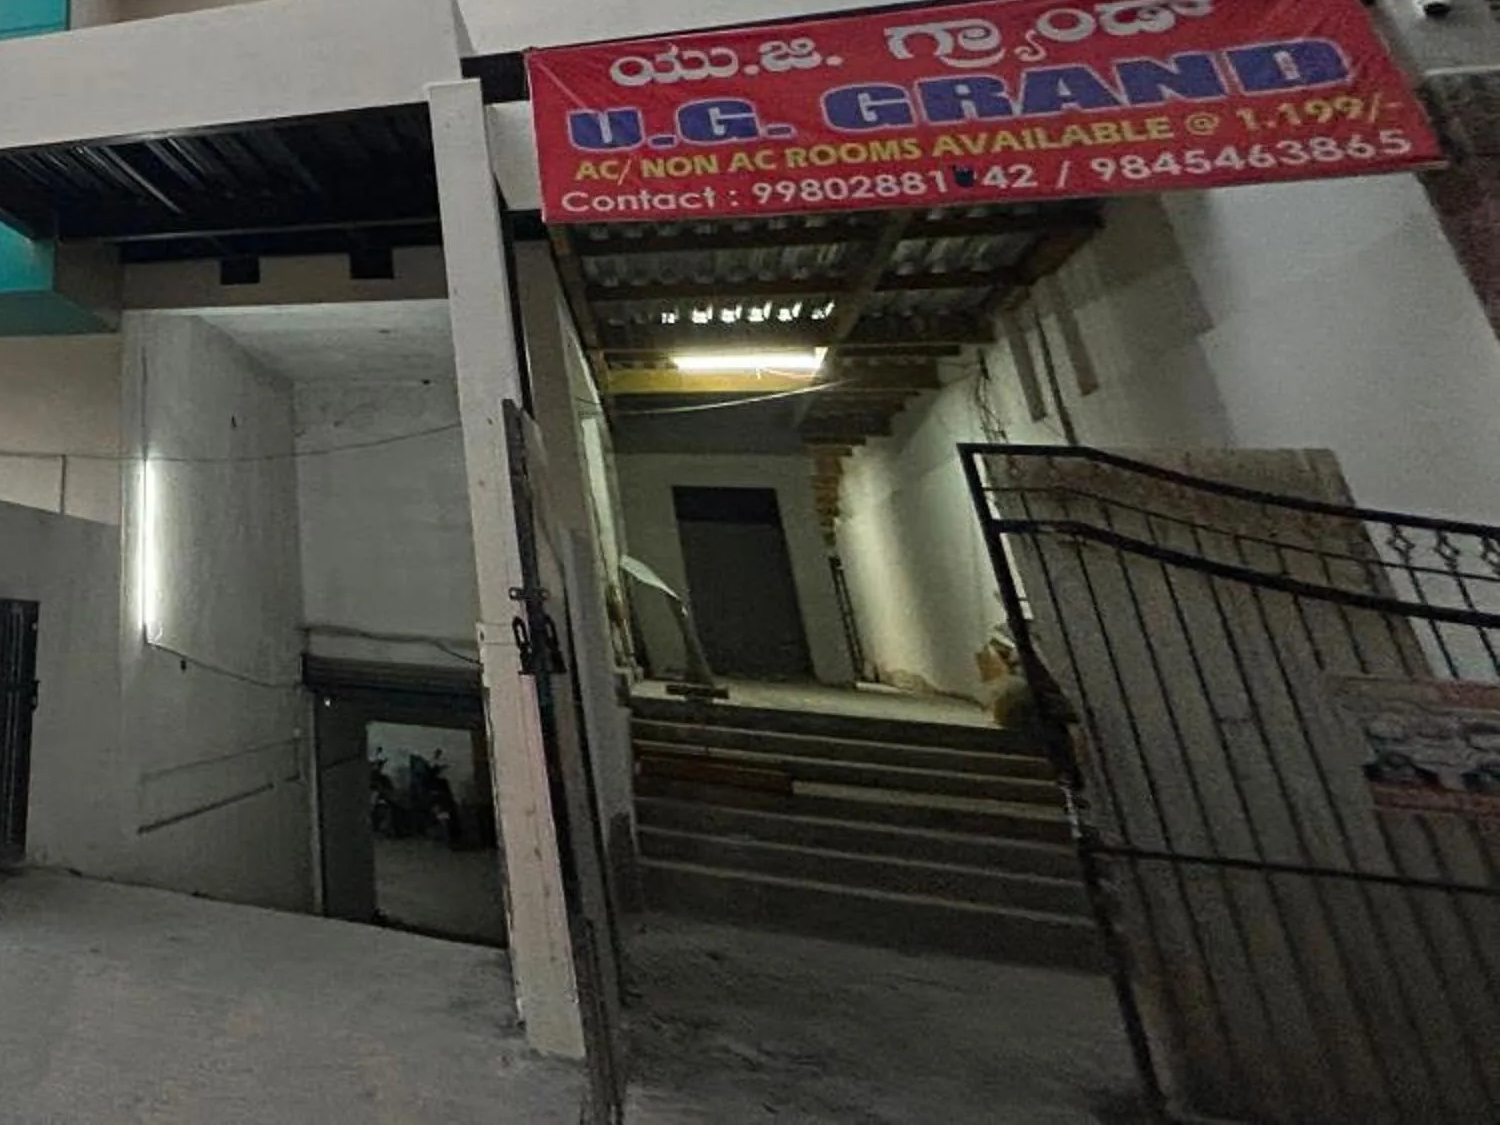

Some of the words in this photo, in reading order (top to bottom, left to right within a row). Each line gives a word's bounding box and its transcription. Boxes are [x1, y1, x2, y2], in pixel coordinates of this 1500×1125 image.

[567, 96, 798, 153] U.G.
[821, 36, 1353, 133] GRAND
[561, 185, 716, 213] Contact
[751, 163, 1040, 205] 9980288142
[1091, 128, 1412, 183] 9845463865
[641, 154, 719, 179] NON
[730, 148, 777, 173] AC
[785, 134, 922, 168] ROOMS
[931, 116, 1174, 157] AVAILABLE
[1186, 111, 1220, 135] @
